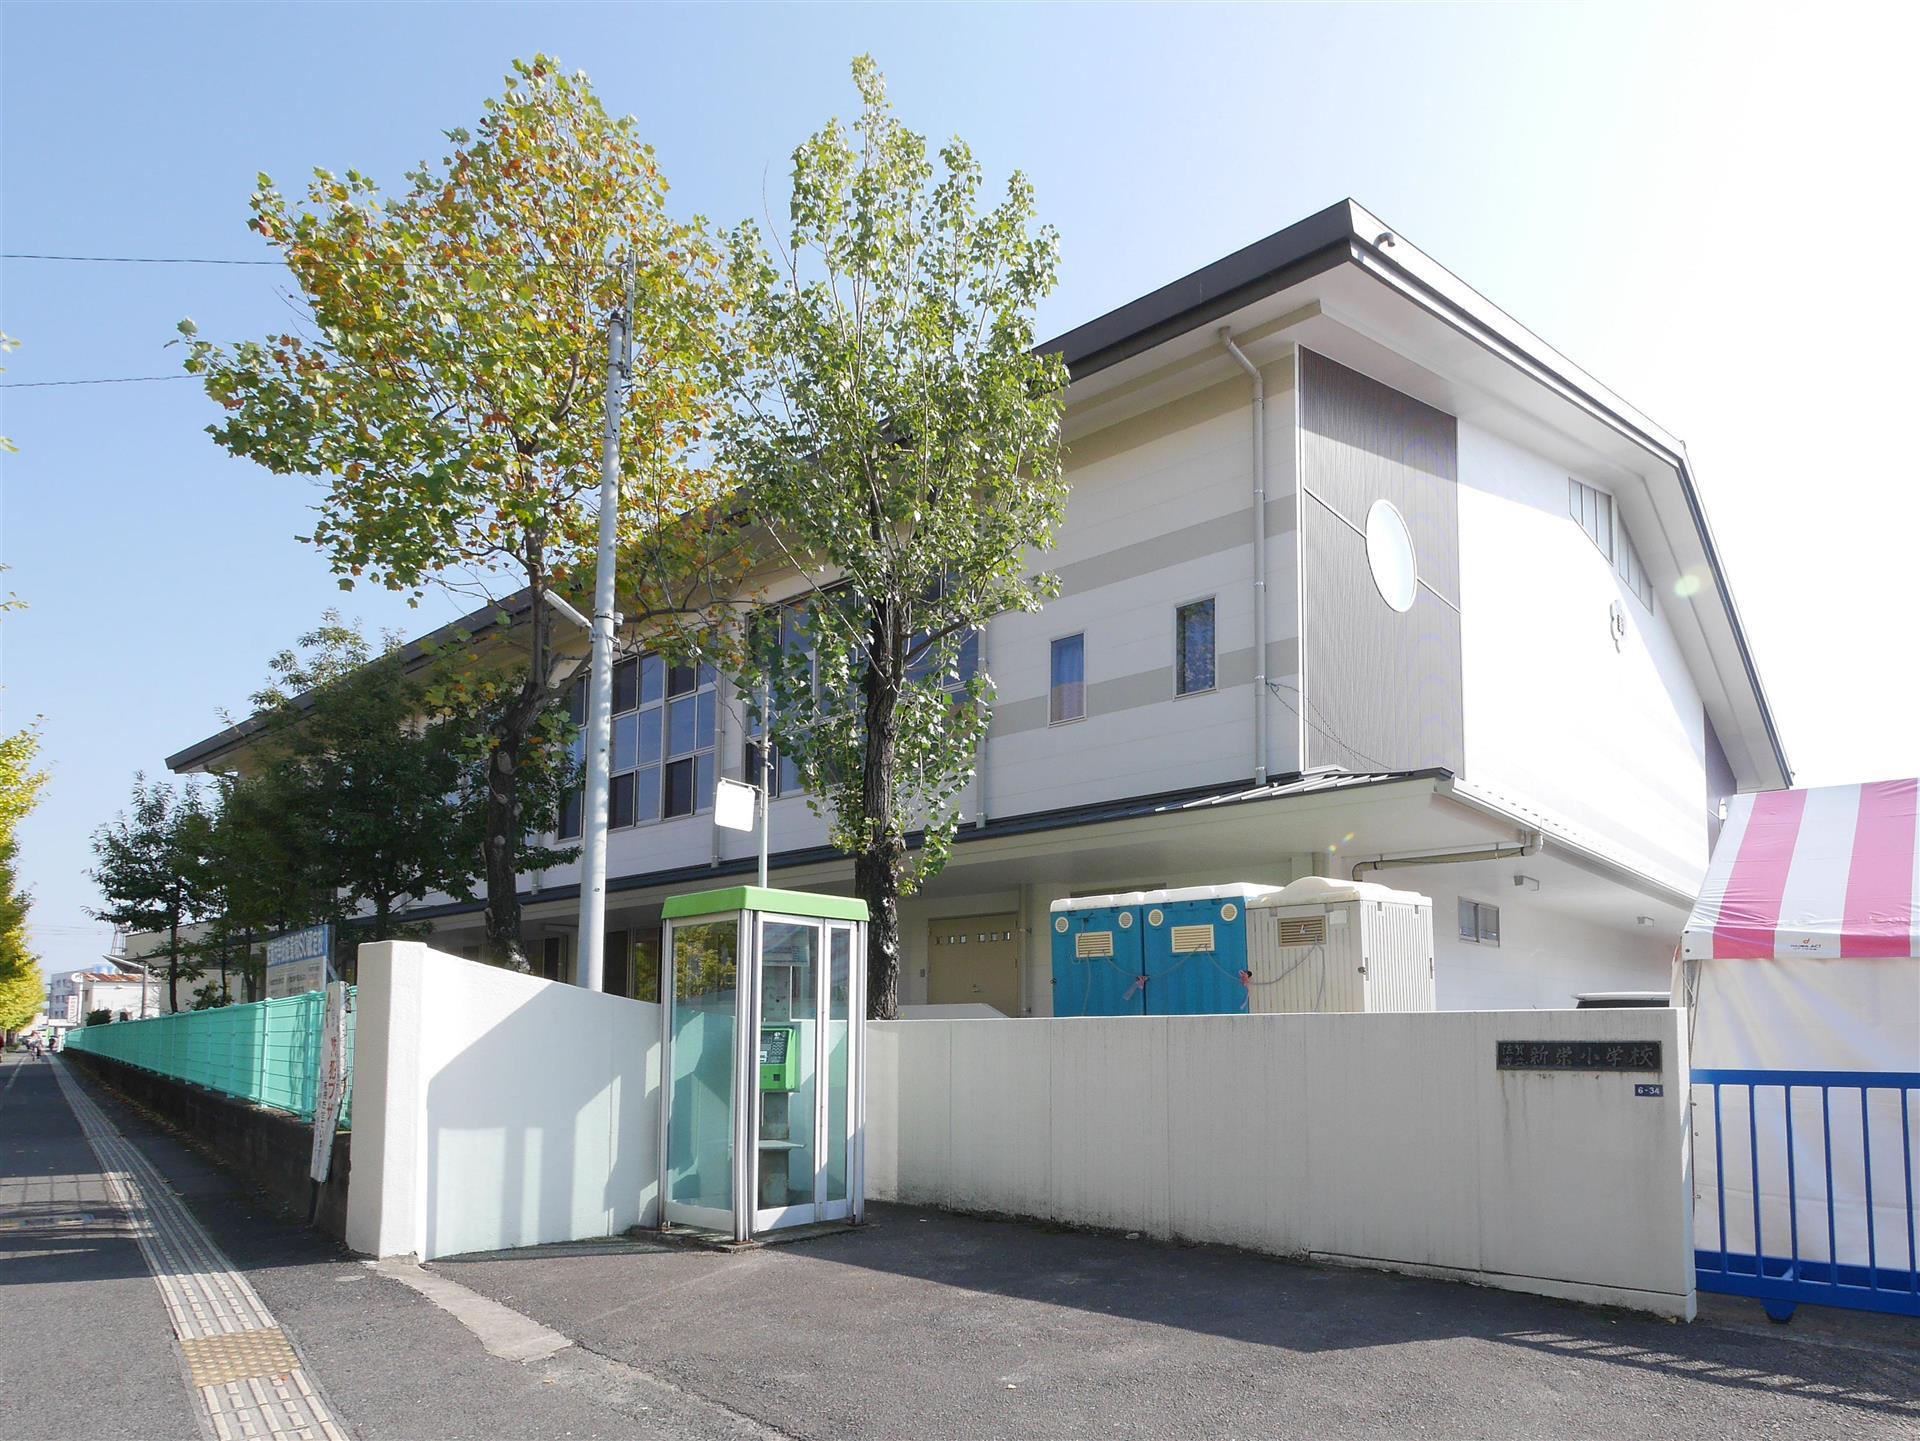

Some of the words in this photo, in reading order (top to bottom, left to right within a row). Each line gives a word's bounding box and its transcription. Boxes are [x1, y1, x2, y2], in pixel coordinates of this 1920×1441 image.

[1530, 1045, 1654, 1068] 新栄小学校
[1637, 1086, 1660, 1095] 6-34
